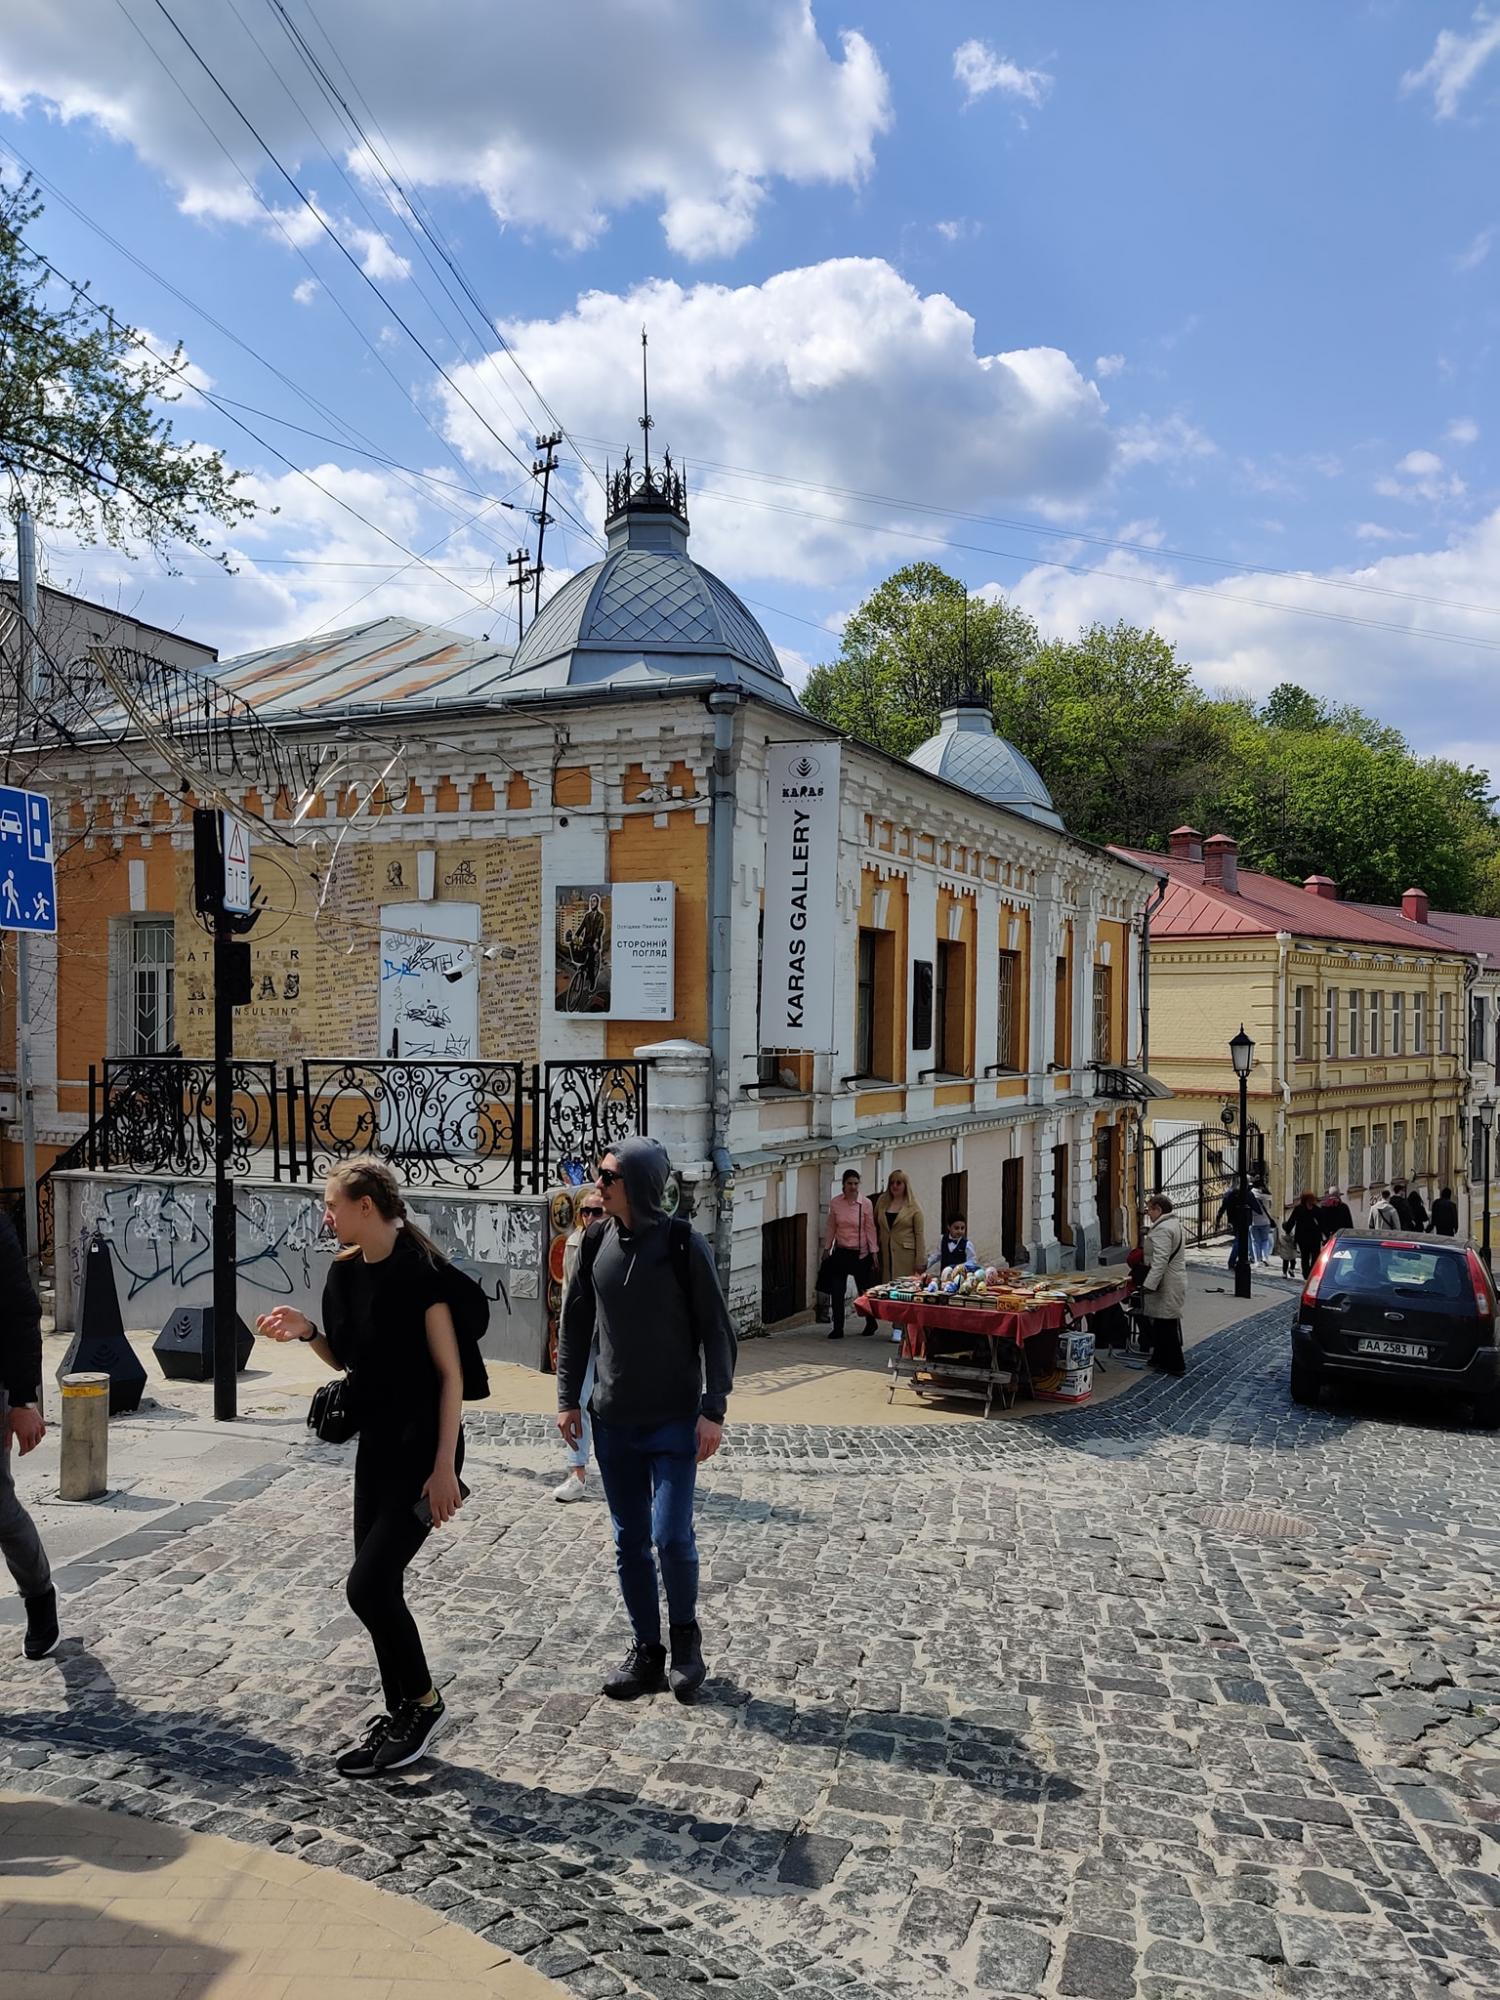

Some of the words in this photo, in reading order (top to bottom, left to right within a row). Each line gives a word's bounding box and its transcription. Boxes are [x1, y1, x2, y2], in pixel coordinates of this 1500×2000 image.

[782, 785, 824, 798] KARAS
[789, 809, 811, 931] GALLERY
[616, 938, 667, 948] СТОРОННІЙ
[187, 949, 300, 962] ATIER
[632, 949, 667, 958] ПОГЛЯД
[787, 938, 807, 1028] KARAS
[234, 1007, 300, 1017] NSULTING
[1366, 1340, 1381, 1352] AA
[1383, 1342, 1407, 1354] 2583
